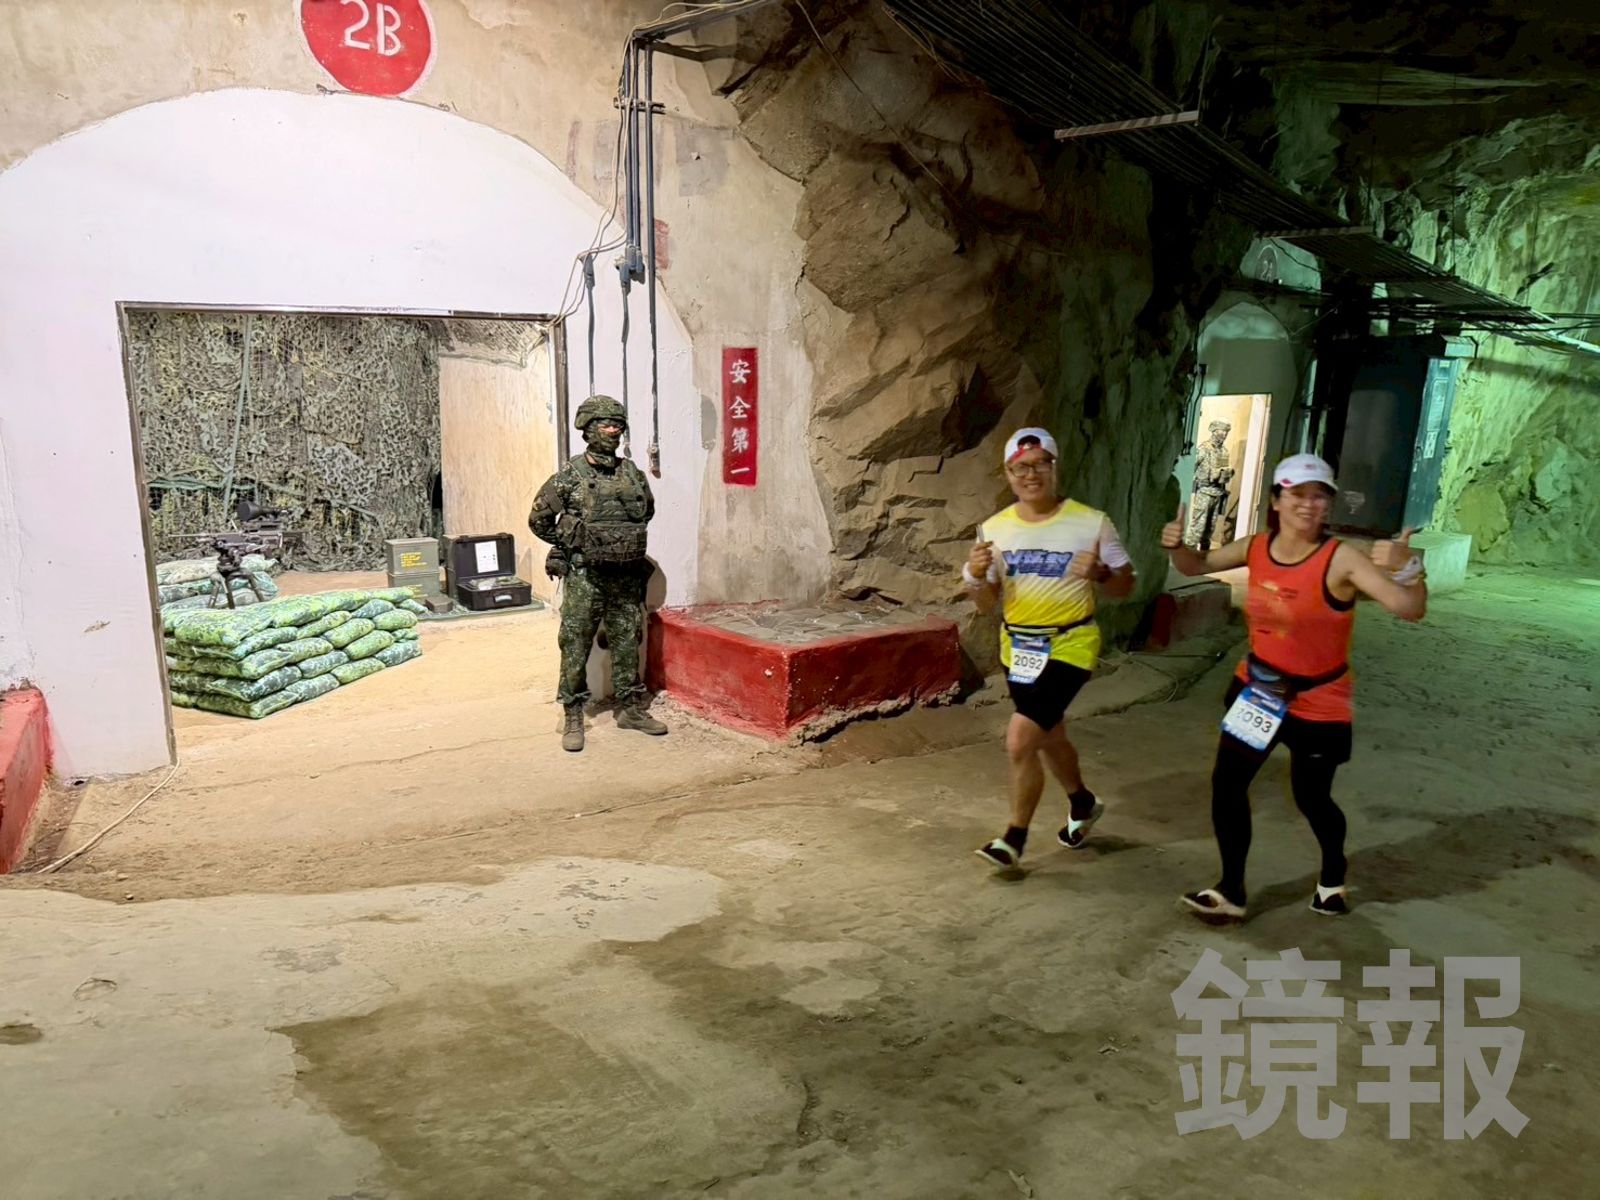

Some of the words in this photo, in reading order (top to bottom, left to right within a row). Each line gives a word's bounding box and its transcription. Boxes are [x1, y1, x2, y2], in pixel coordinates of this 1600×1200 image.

[341, 0, 401, 56] 2B
[729, 359, 751, 474] 安全第一
[1014, 654, 1043, 670] 2092
